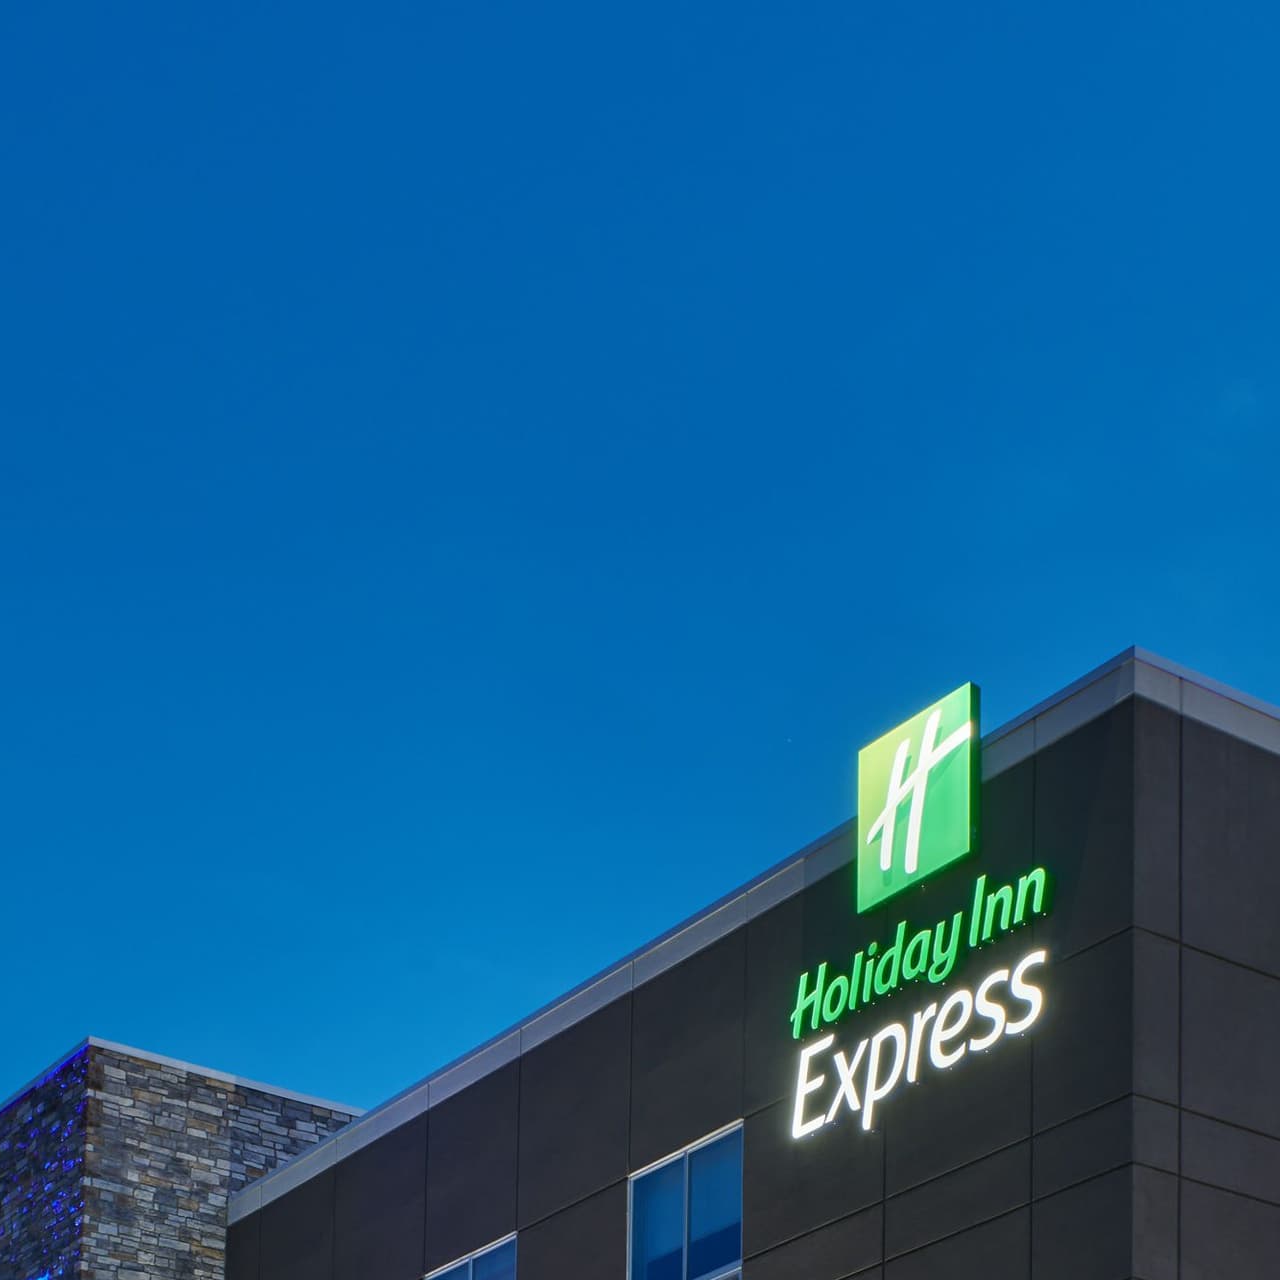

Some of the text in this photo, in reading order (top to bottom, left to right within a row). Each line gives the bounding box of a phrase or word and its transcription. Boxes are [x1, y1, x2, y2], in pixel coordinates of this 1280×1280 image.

[866, 708, 973, 874] H
[790, 866, 1047, 1040] Holiday Inn
[791, 950, 1047, 1139] Express
